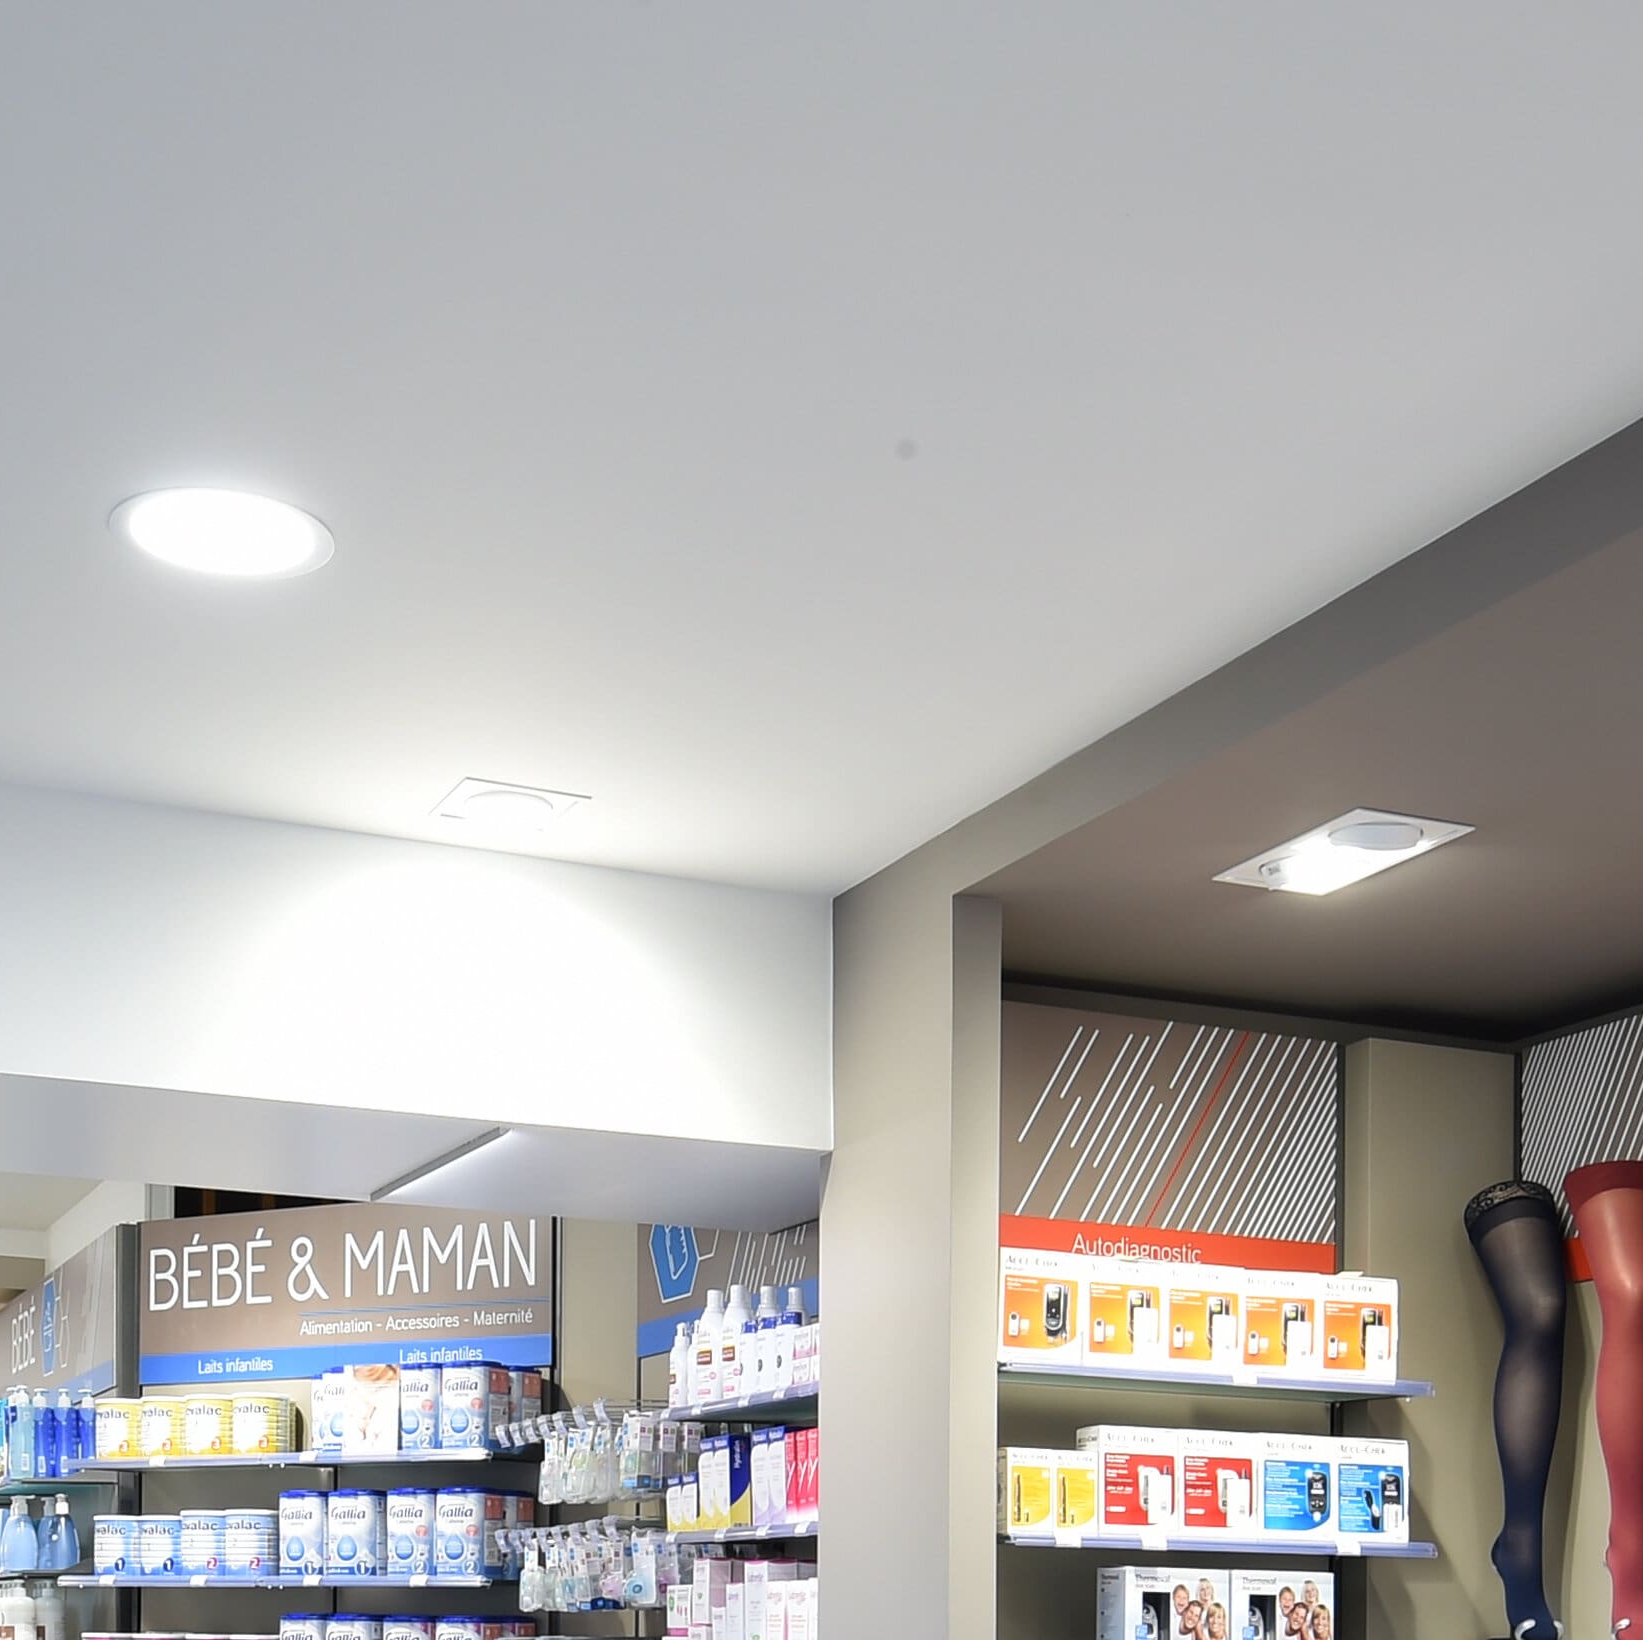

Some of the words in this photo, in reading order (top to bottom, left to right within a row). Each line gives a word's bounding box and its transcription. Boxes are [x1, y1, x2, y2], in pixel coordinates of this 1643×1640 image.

[1072, 1233, 1202, 1263] Autodiagnostic
[149, 1228, 272, 1311] BÉBÉ
[288, 1236, 329, 1301] &
[345, 1219, 535, 1297] MAMAN
[12, 1296, 35, 1374] BÉBÉ
[300, 1319, 373, 1336] Alimentation
[386, 1314, 459, 1331] Accessoires
[474, 1308, 532, 1326] Maternité
[198, 1360, 223, 1374] Laits
[226, 1358, 273, 1372] infantiles
[399, 1349, 427, 1364] Laits
[430, 1347, 483, 1361] infantiles
